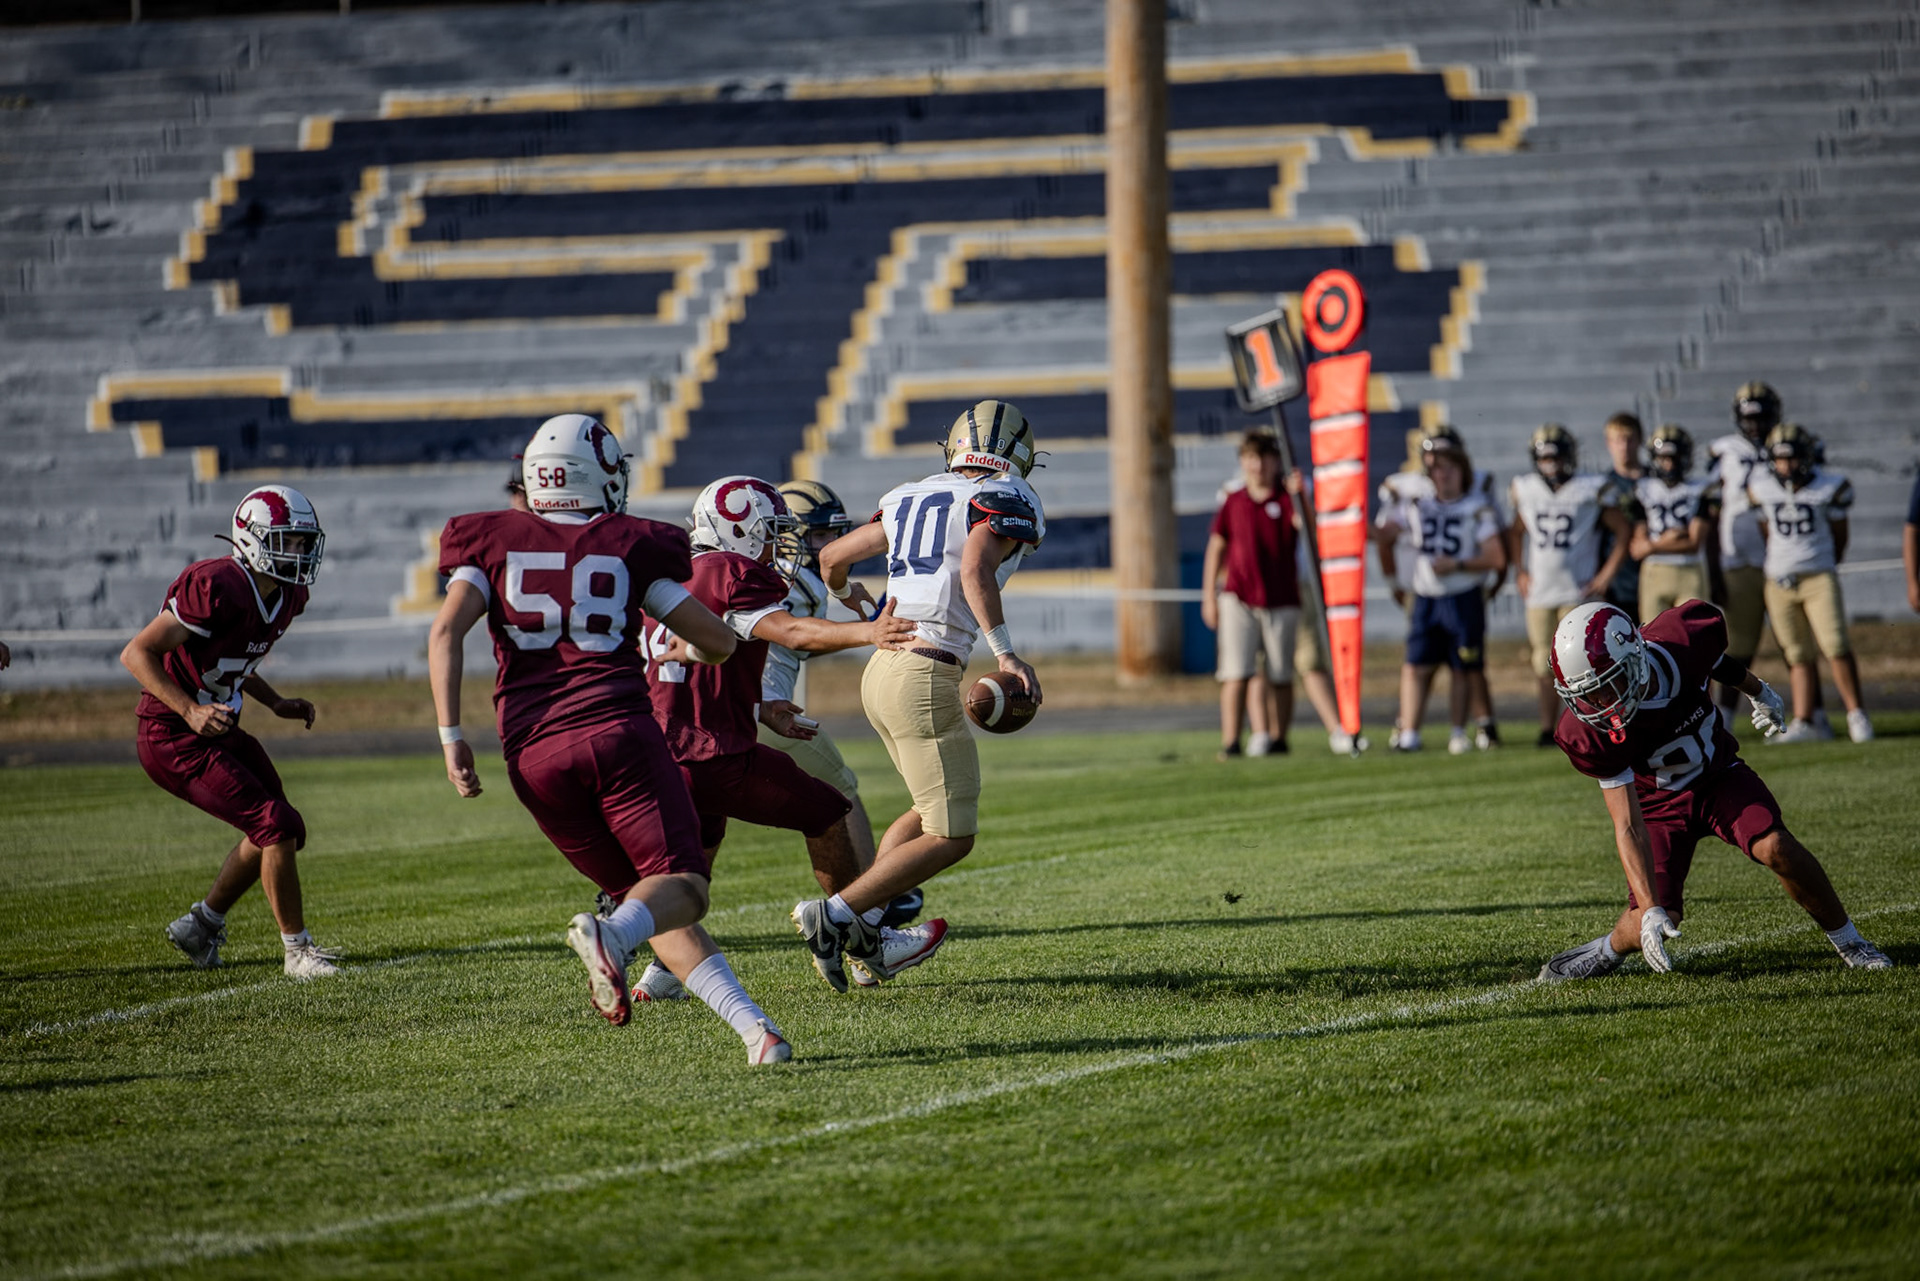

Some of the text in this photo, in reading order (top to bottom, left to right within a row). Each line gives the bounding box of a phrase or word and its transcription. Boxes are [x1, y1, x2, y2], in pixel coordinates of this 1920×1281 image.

[1245, 326, 1284, 390] 1
[964, 453, 1011, 473] Riddell
[533, 499, 580, 509] Riddell
[889, 491, 955, 578] 10
[1421, 517, 1462, 555] 25
[1536, 514, 1574, 548] 52
[502, 551, 630, 653] 58
